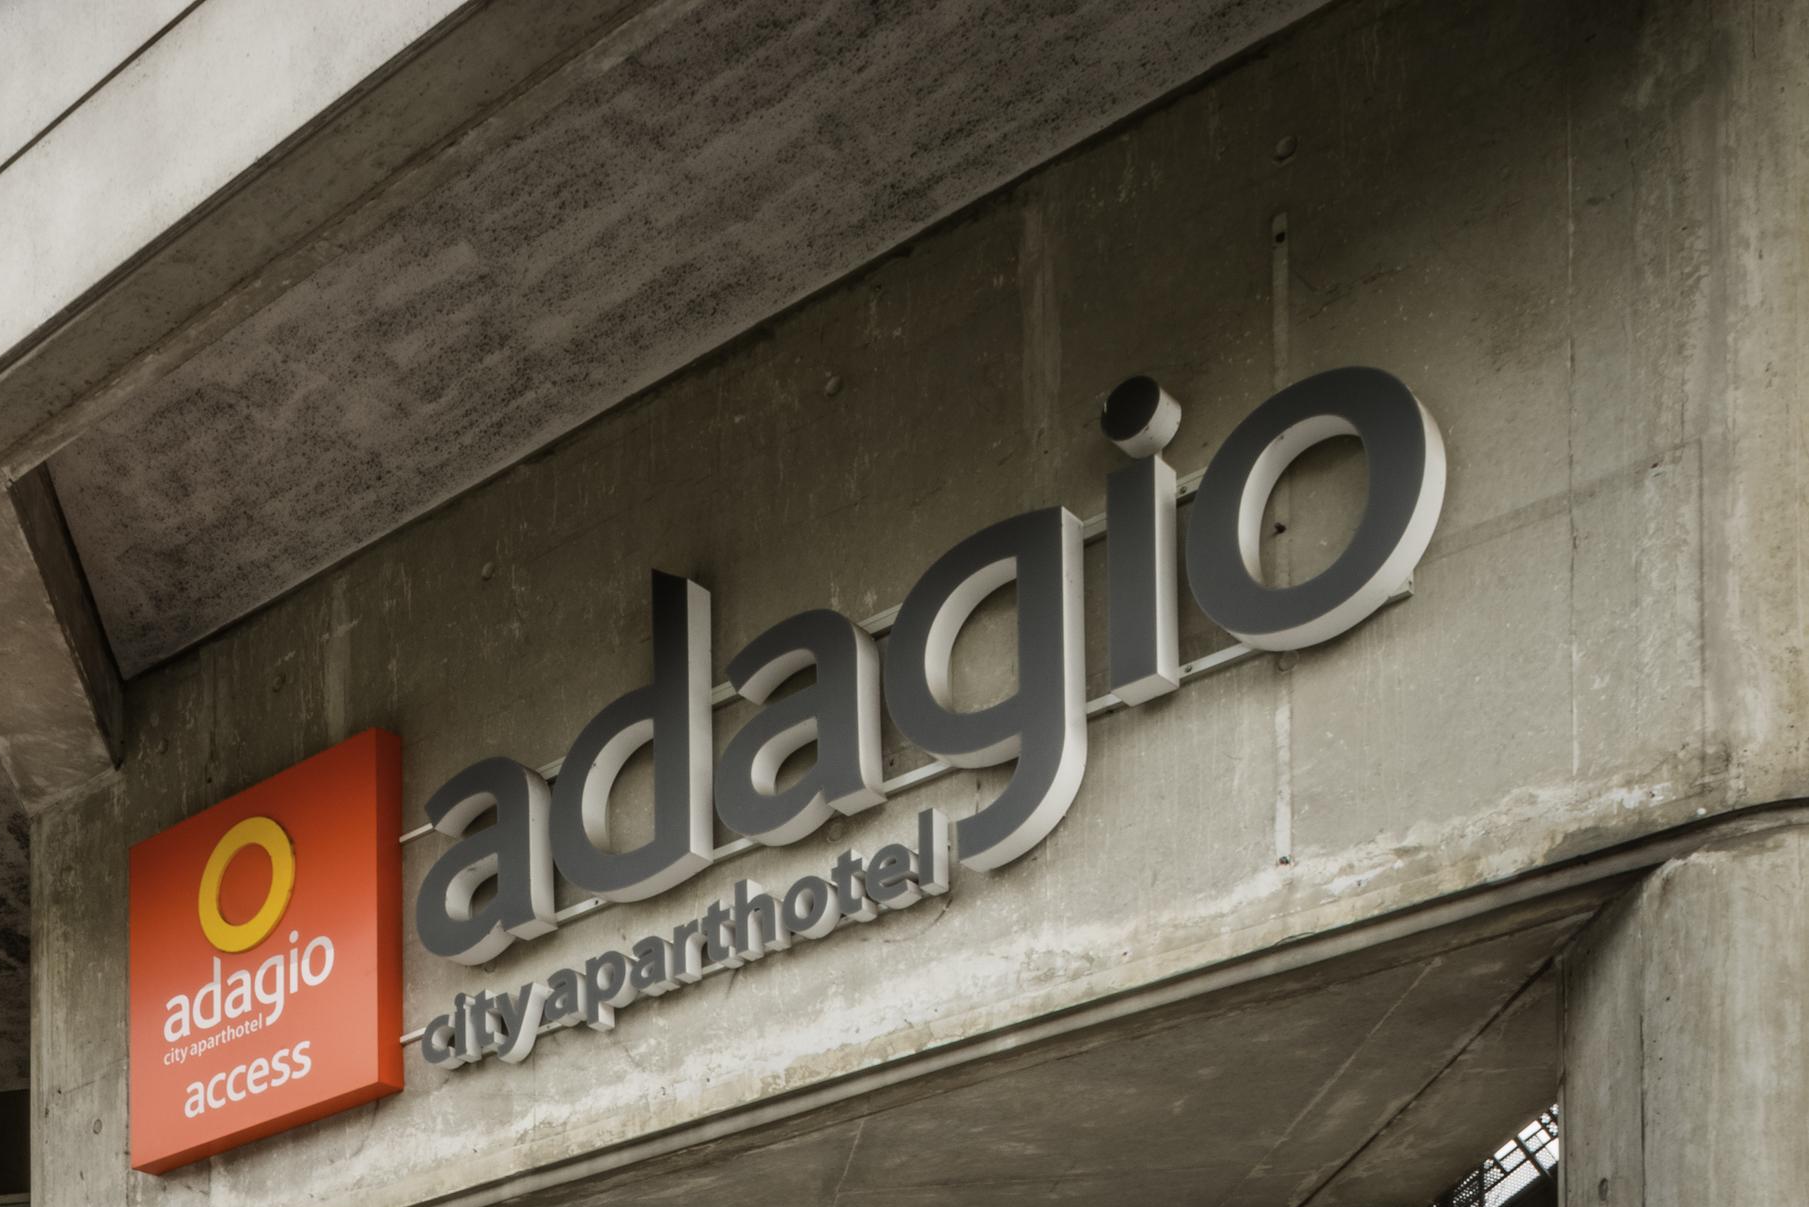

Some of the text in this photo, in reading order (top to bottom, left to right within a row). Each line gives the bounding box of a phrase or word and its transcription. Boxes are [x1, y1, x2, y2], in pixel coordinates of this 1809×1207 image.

[416, 365, 1446, 965] adagio
[163, 930, 335, 1043] adagio
[421, 807, 949, 1068] city aparthotel
[163, 1013, 263, 1067] city aparthotel
[184, 1040, 312, 1118] access
